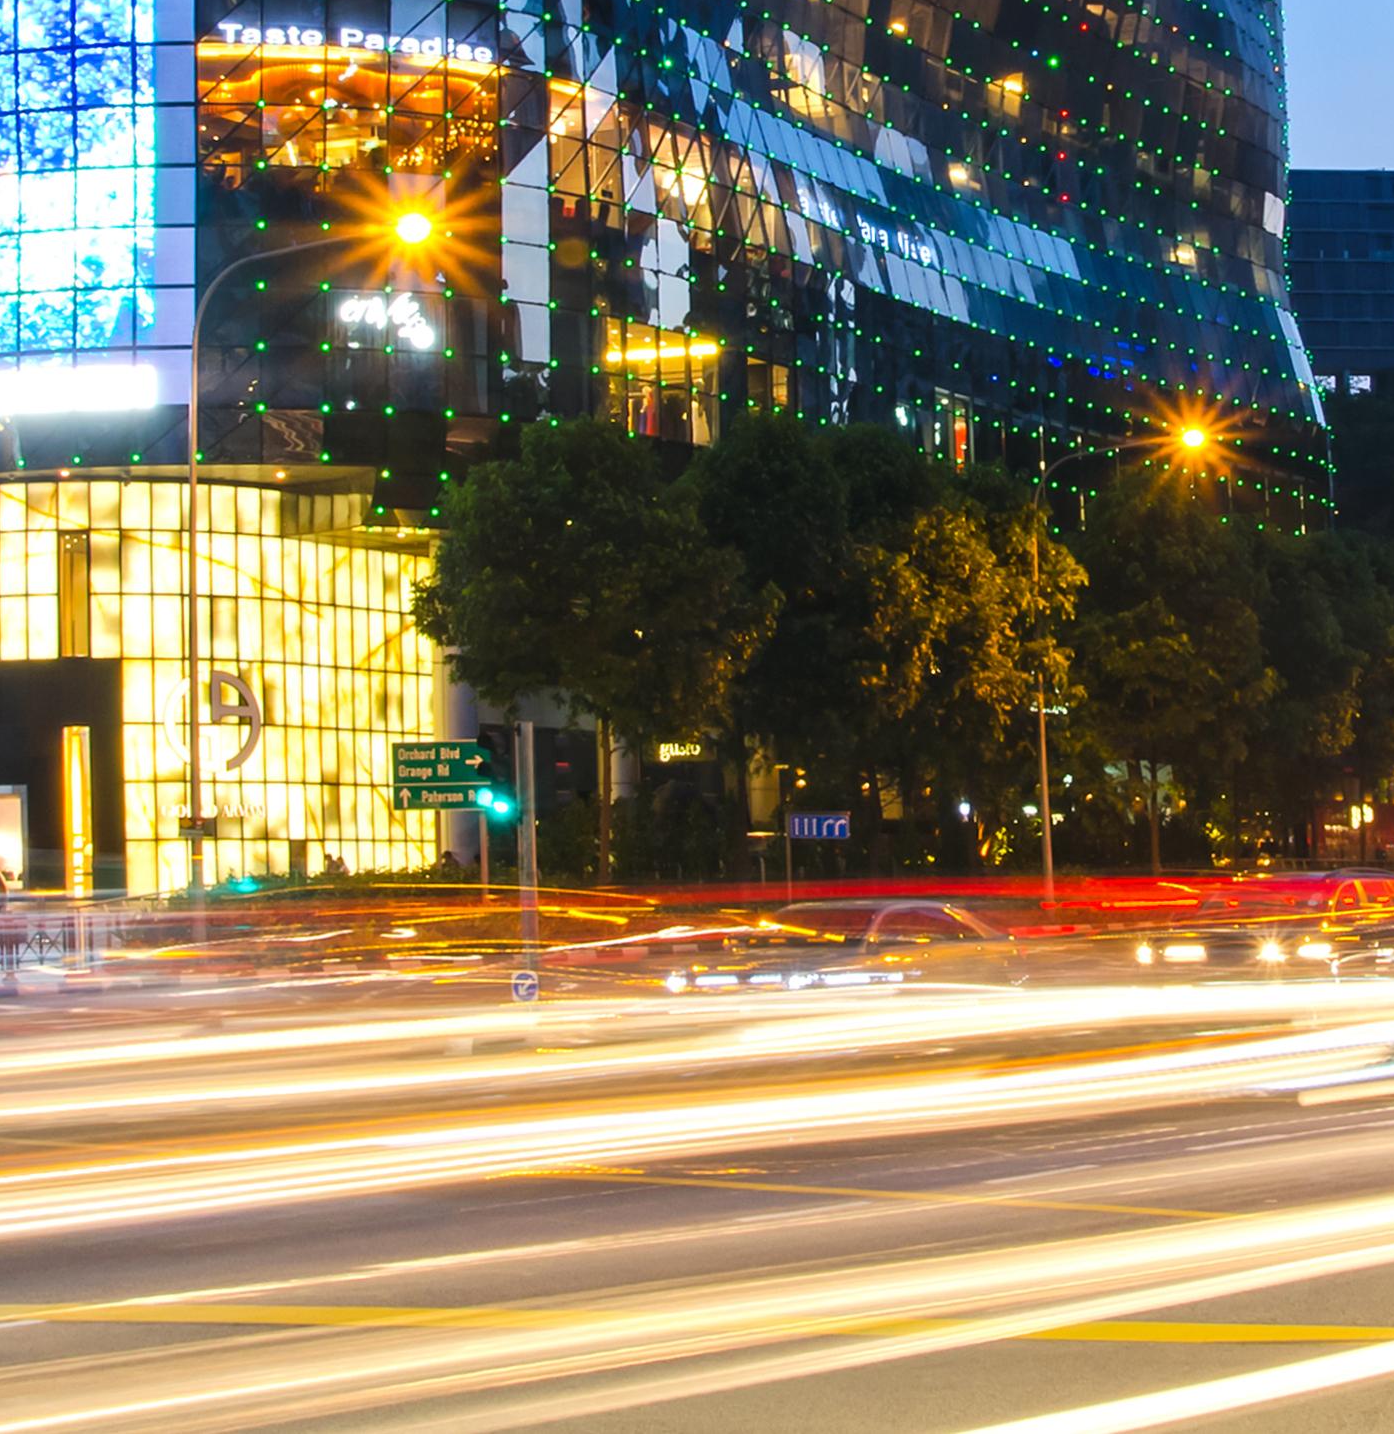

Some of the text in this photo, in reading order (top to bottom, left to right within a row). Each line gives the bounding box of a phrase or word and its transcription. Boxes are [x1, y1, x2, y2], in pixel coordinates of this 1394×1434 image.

[217, 22, 494, 64] Taste Paradise
[397, 746, 460, 761] Orchard Blvd
[397, 763, 450, 780] Grange Rd
[421, 789, 464, 803] Paterson
